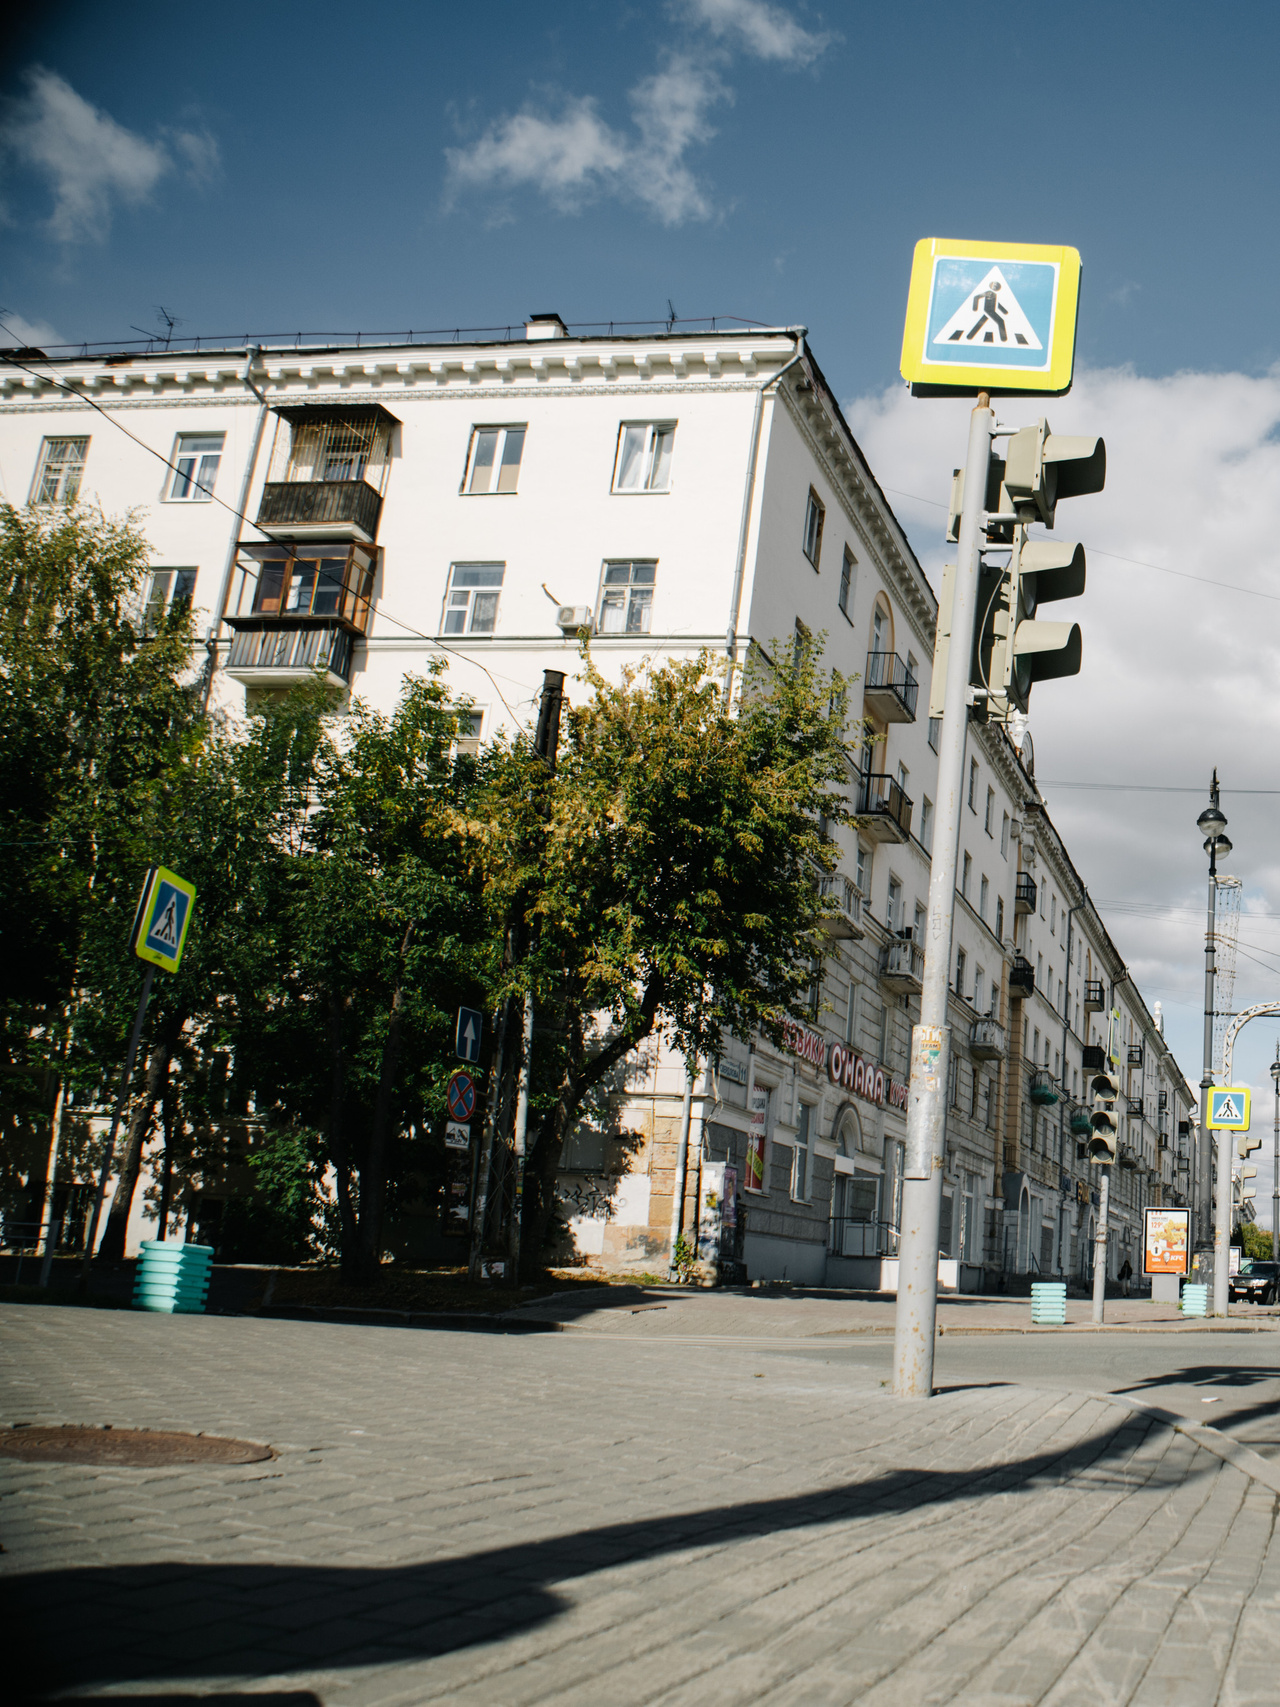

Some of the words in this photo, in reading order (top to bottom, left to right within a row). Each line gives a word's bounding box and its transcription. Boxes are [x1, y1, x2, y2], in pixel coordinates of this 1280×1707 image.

[740, 1067, 747, 1081] 11
[830, 1042, 884, 1105] O'HARA
[889, 1078, 909, 1110] КУРТ
